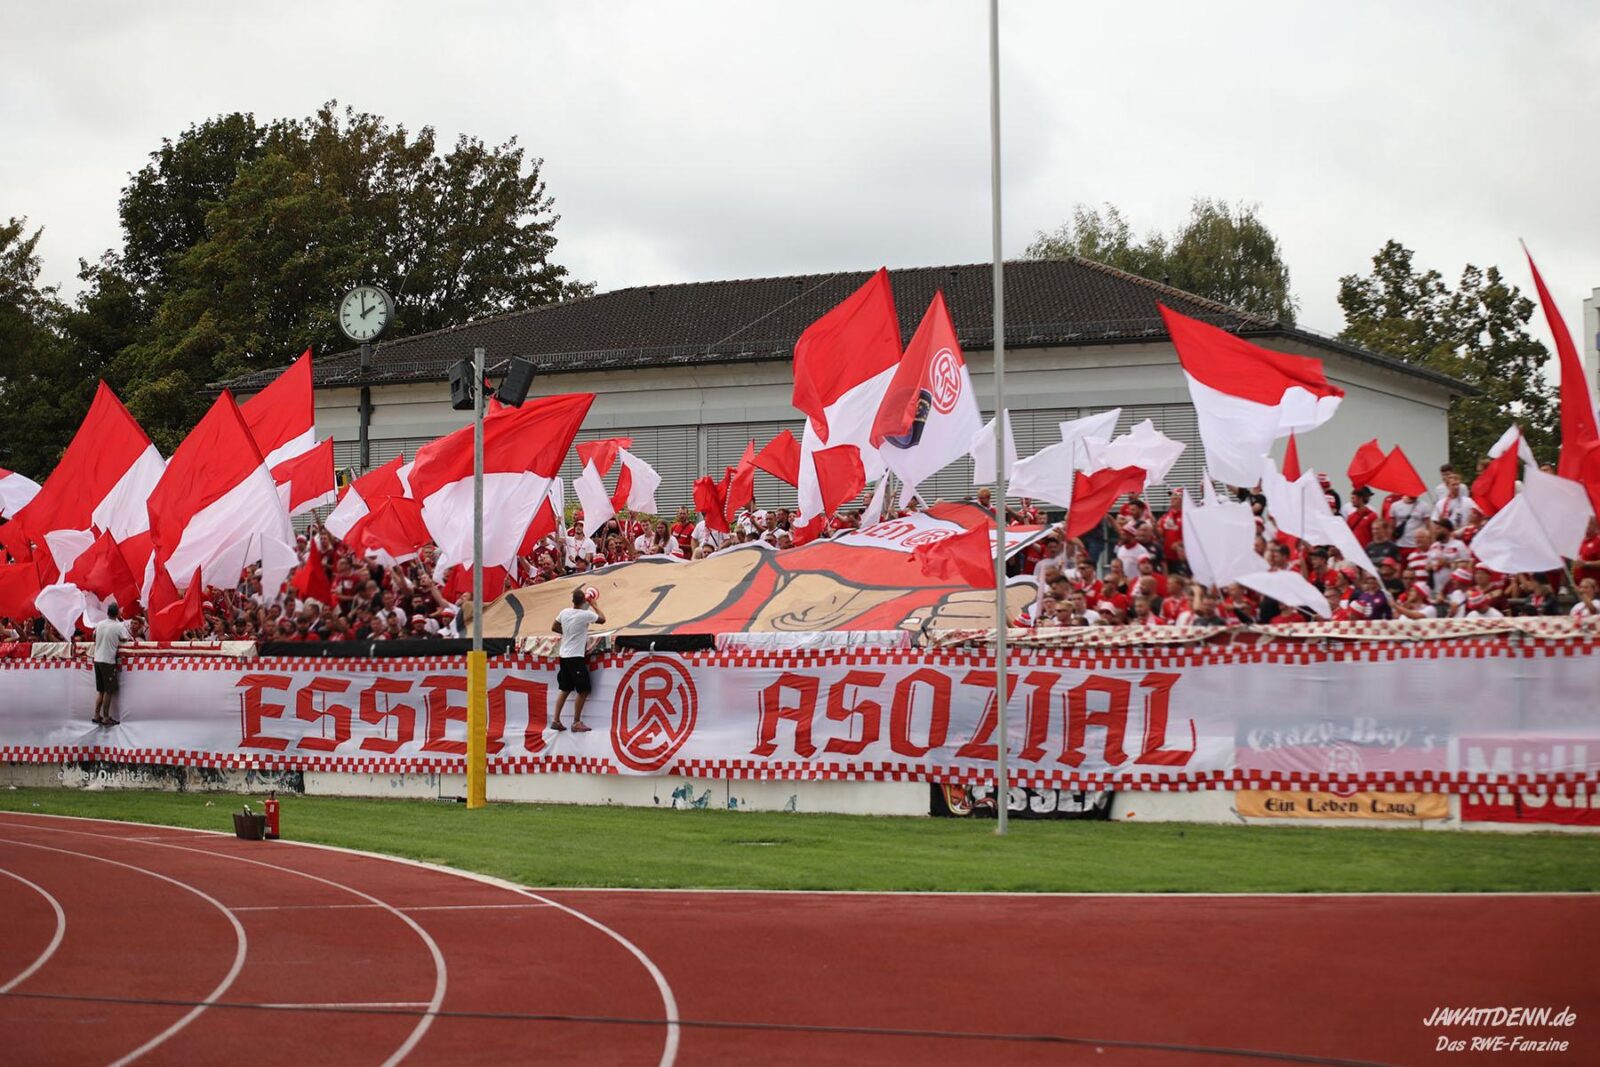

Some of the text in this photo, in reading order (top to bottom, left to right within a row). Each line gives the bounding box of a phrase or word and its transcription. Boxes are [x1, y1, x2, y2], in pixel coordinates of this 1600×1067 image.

[236, 673, 548, 755] ESSEN
[749, 667, 1197, 768] ASOZIAL
[1264, 798, 1416, 815] Ein Leben Lang
